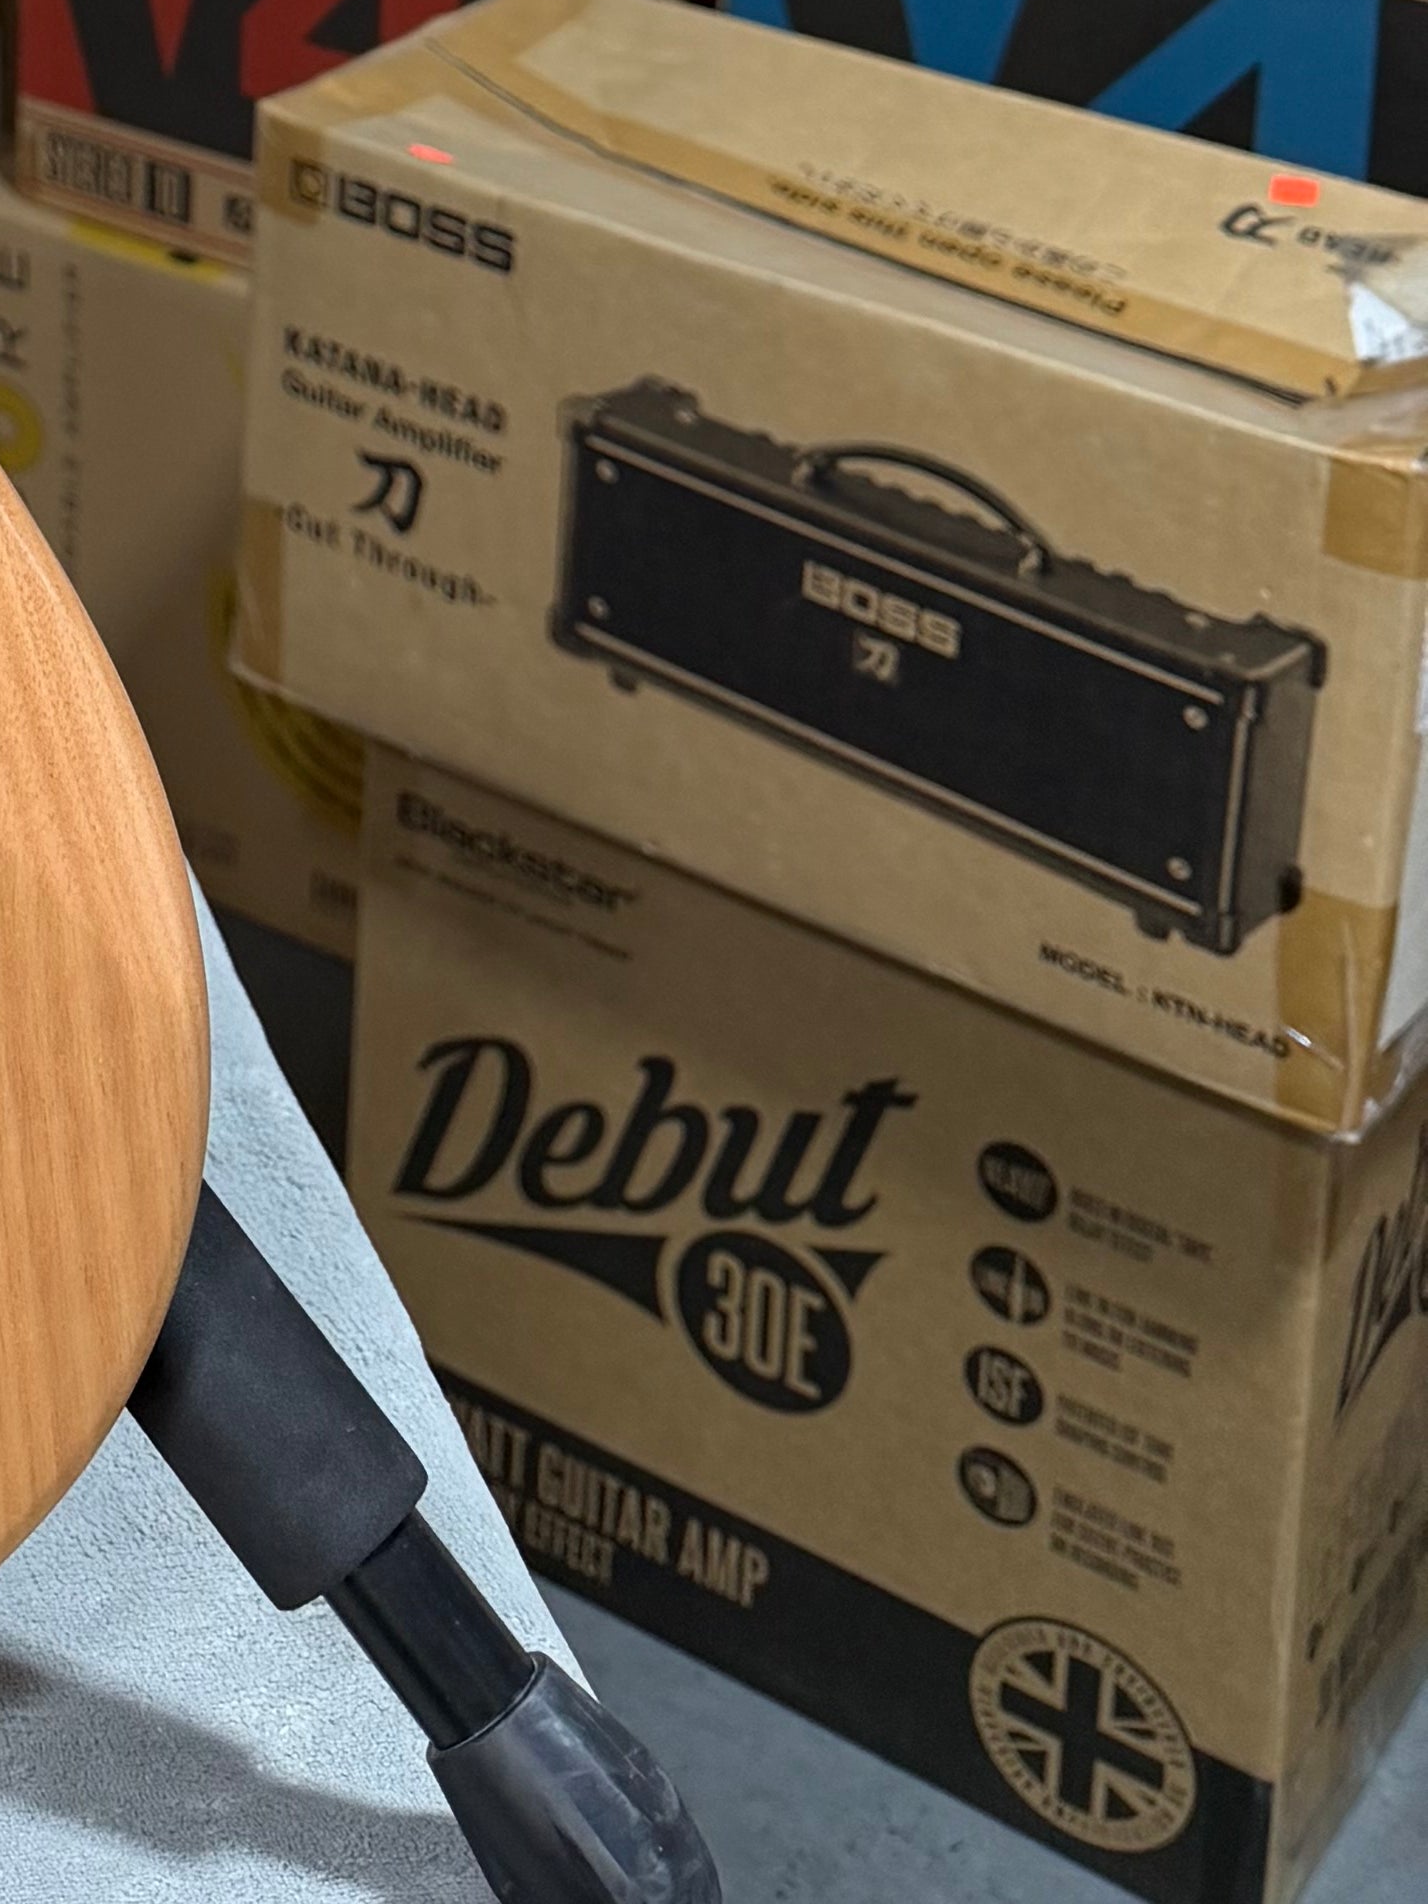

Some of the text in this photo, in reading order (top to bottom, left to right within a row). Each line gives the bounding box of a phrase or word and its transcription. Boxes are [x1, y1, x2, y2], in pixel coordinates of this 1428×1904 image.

[335, 169, 518, 276] BOSS
[280, 366, 502, 474] Guitar Amplifier
[283, 325, 510, 436] KATANA-HEAD
[802, 558, 963, 661] BOSS
[1039, 941, 1128, 996] MODEL
[389, 1034, 920, 1228] Debut
[705, 1255, 829, 1400] 30E
[537, 1442, 673, 1567] GUITAR
[675, 1518, 771, 1610] AMP
